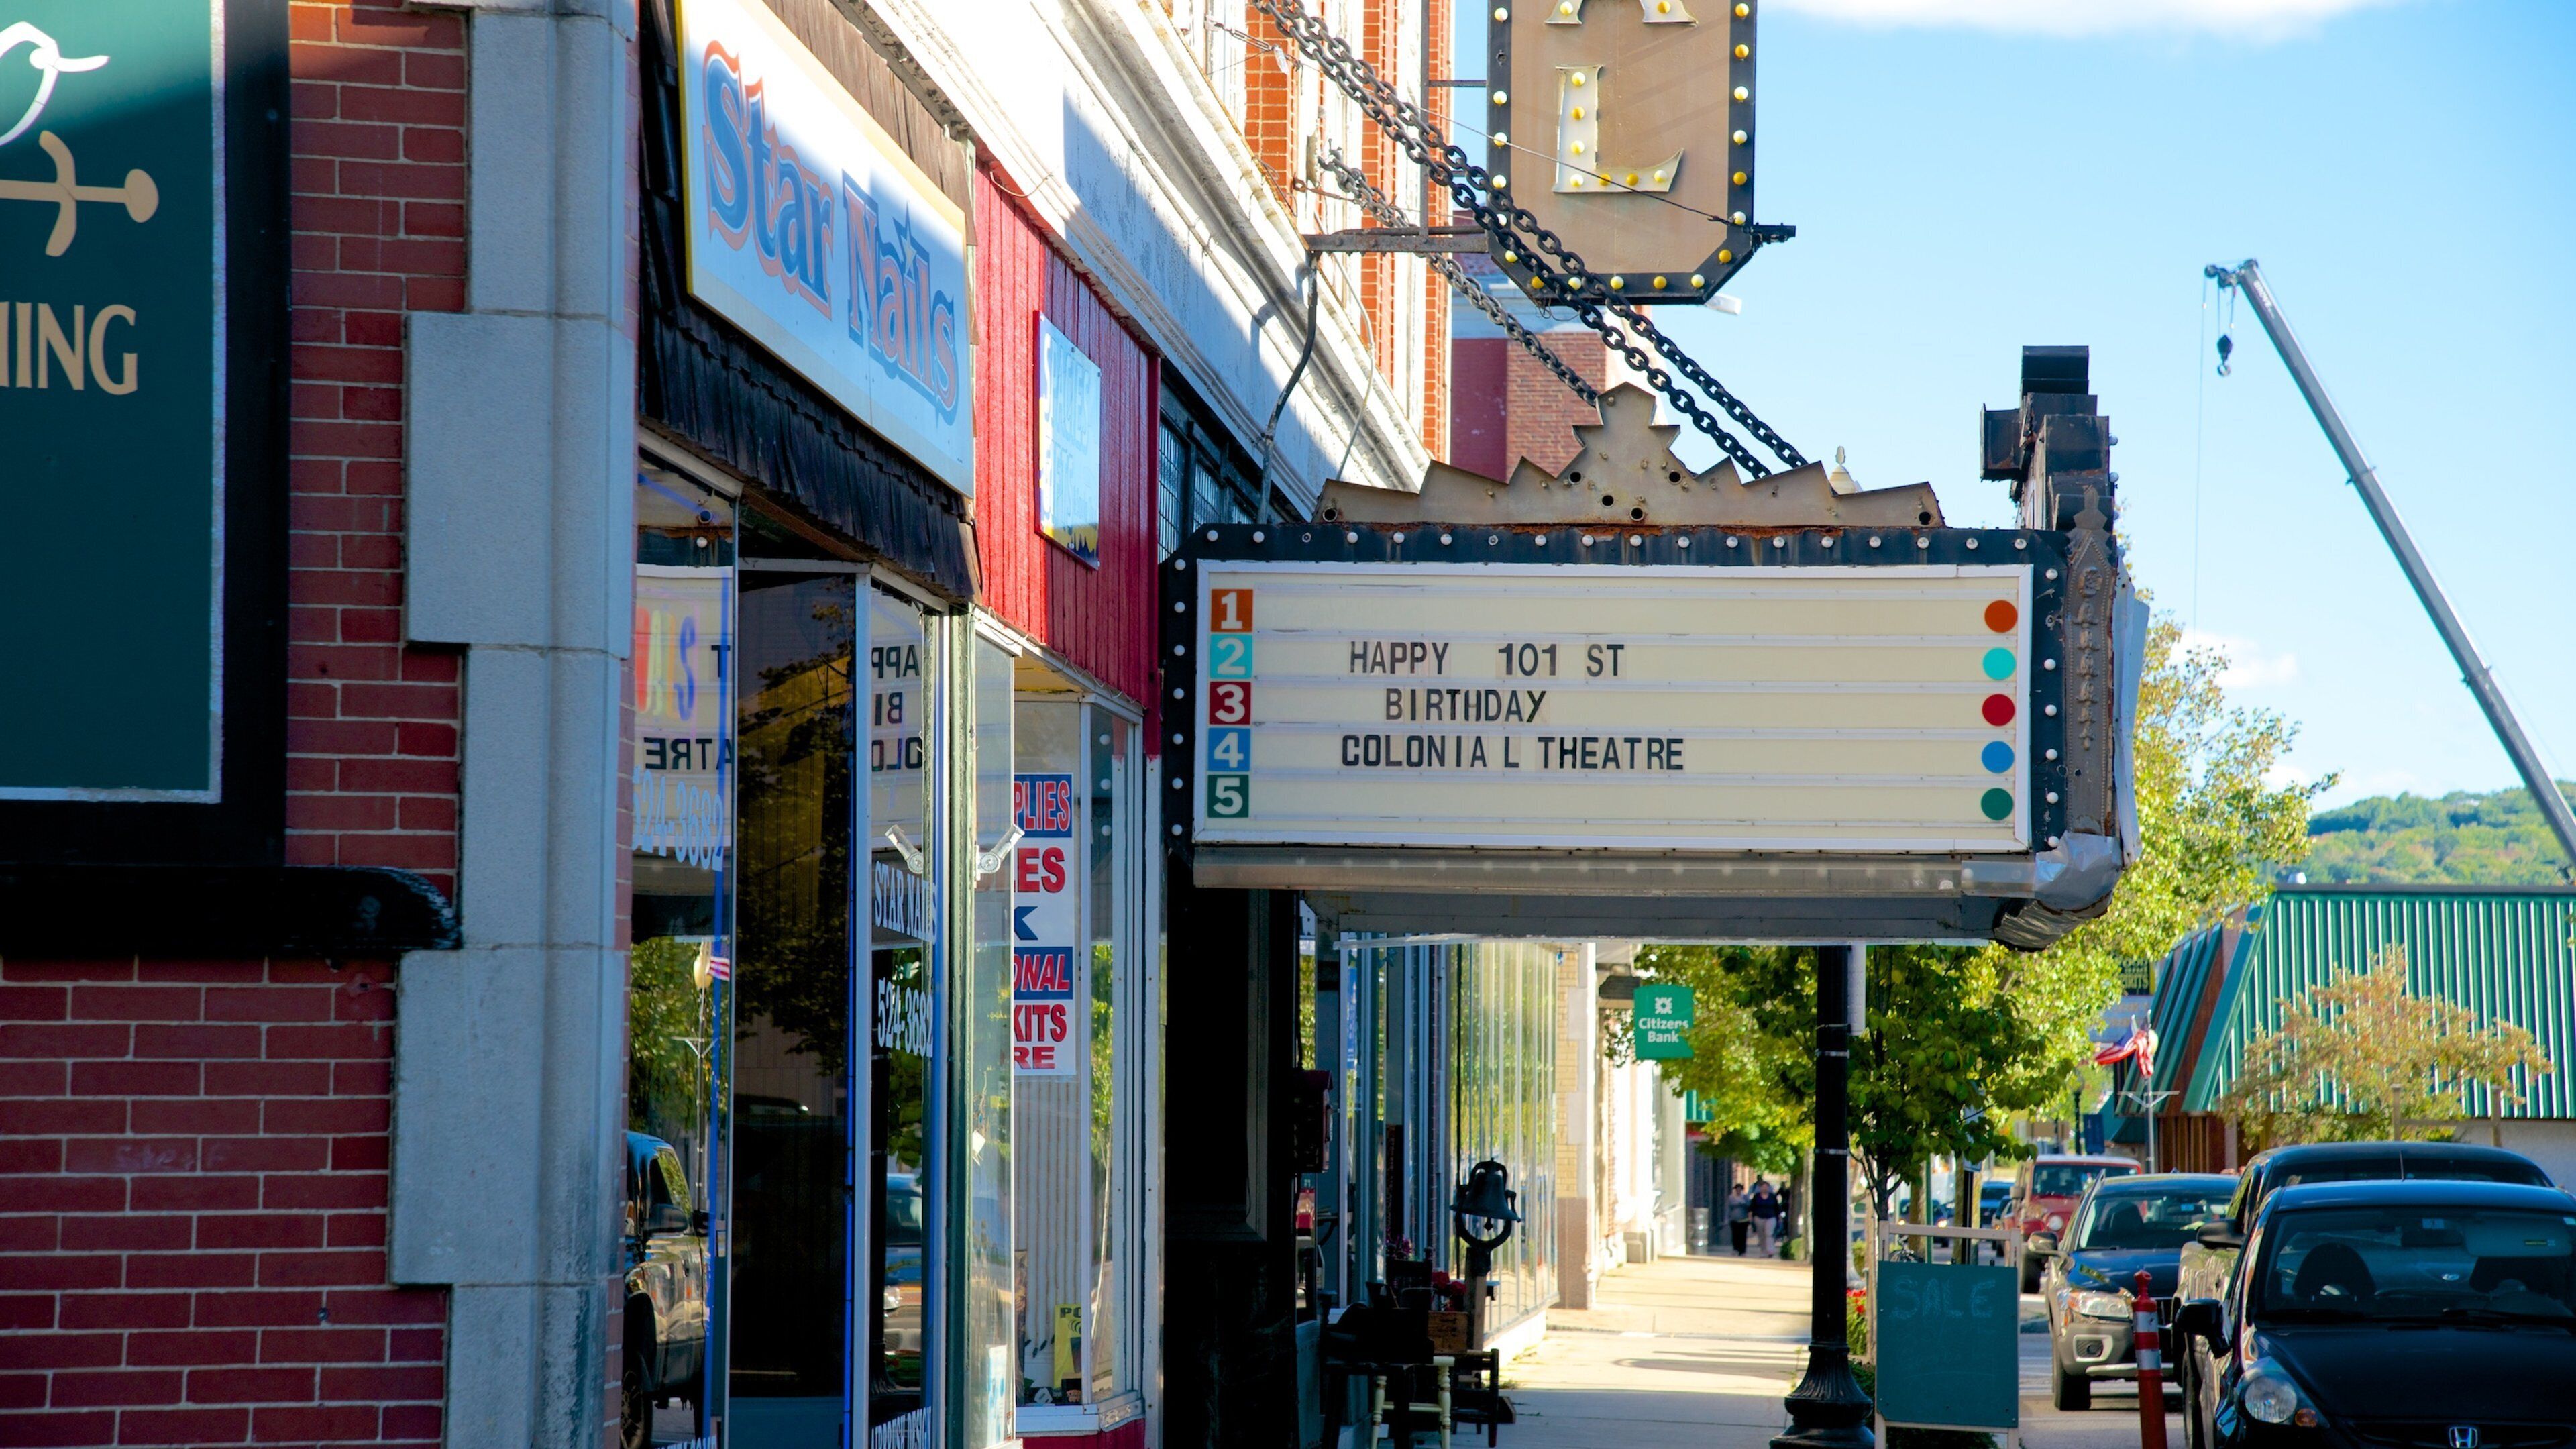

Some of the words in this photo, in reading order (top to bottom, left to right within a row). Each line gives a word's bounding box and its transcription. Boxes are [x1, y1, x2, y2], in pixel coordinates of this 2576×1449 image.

[702, 40, 834, 321] Star
[842, 169, 959, 426] Nails
[0, 301, 138, 395] ING
[1220, 592, 1243, 630] 1
[1216, 638, 1246, 675] 2
[1350, 641, 1449, 675] HAPPY
[1499, 643, 1558, 676] 101
[1587, 643, 1624, 677] ST
[1215, 684, 1245, 722] 3
[1386, 688, 1546, 723] BIRTHDAY
[1214, 732, 1244, 767] 4
[1538, 737, 1684, 770] THEATRE
[1214, 779, 1243, 816] 5
[1013, 847, 1065, 893] ES
[875, 861, 904, 934] STAR
[907, 873, 937, 945] NAILS
[877, 977, 934, 1058] 524-3682
[1638, 1017, 1689, 1030] Citizens
[1647, 1030, 1680, 1043] Bank
[1890, 1275, 1996, 1320] SALE
